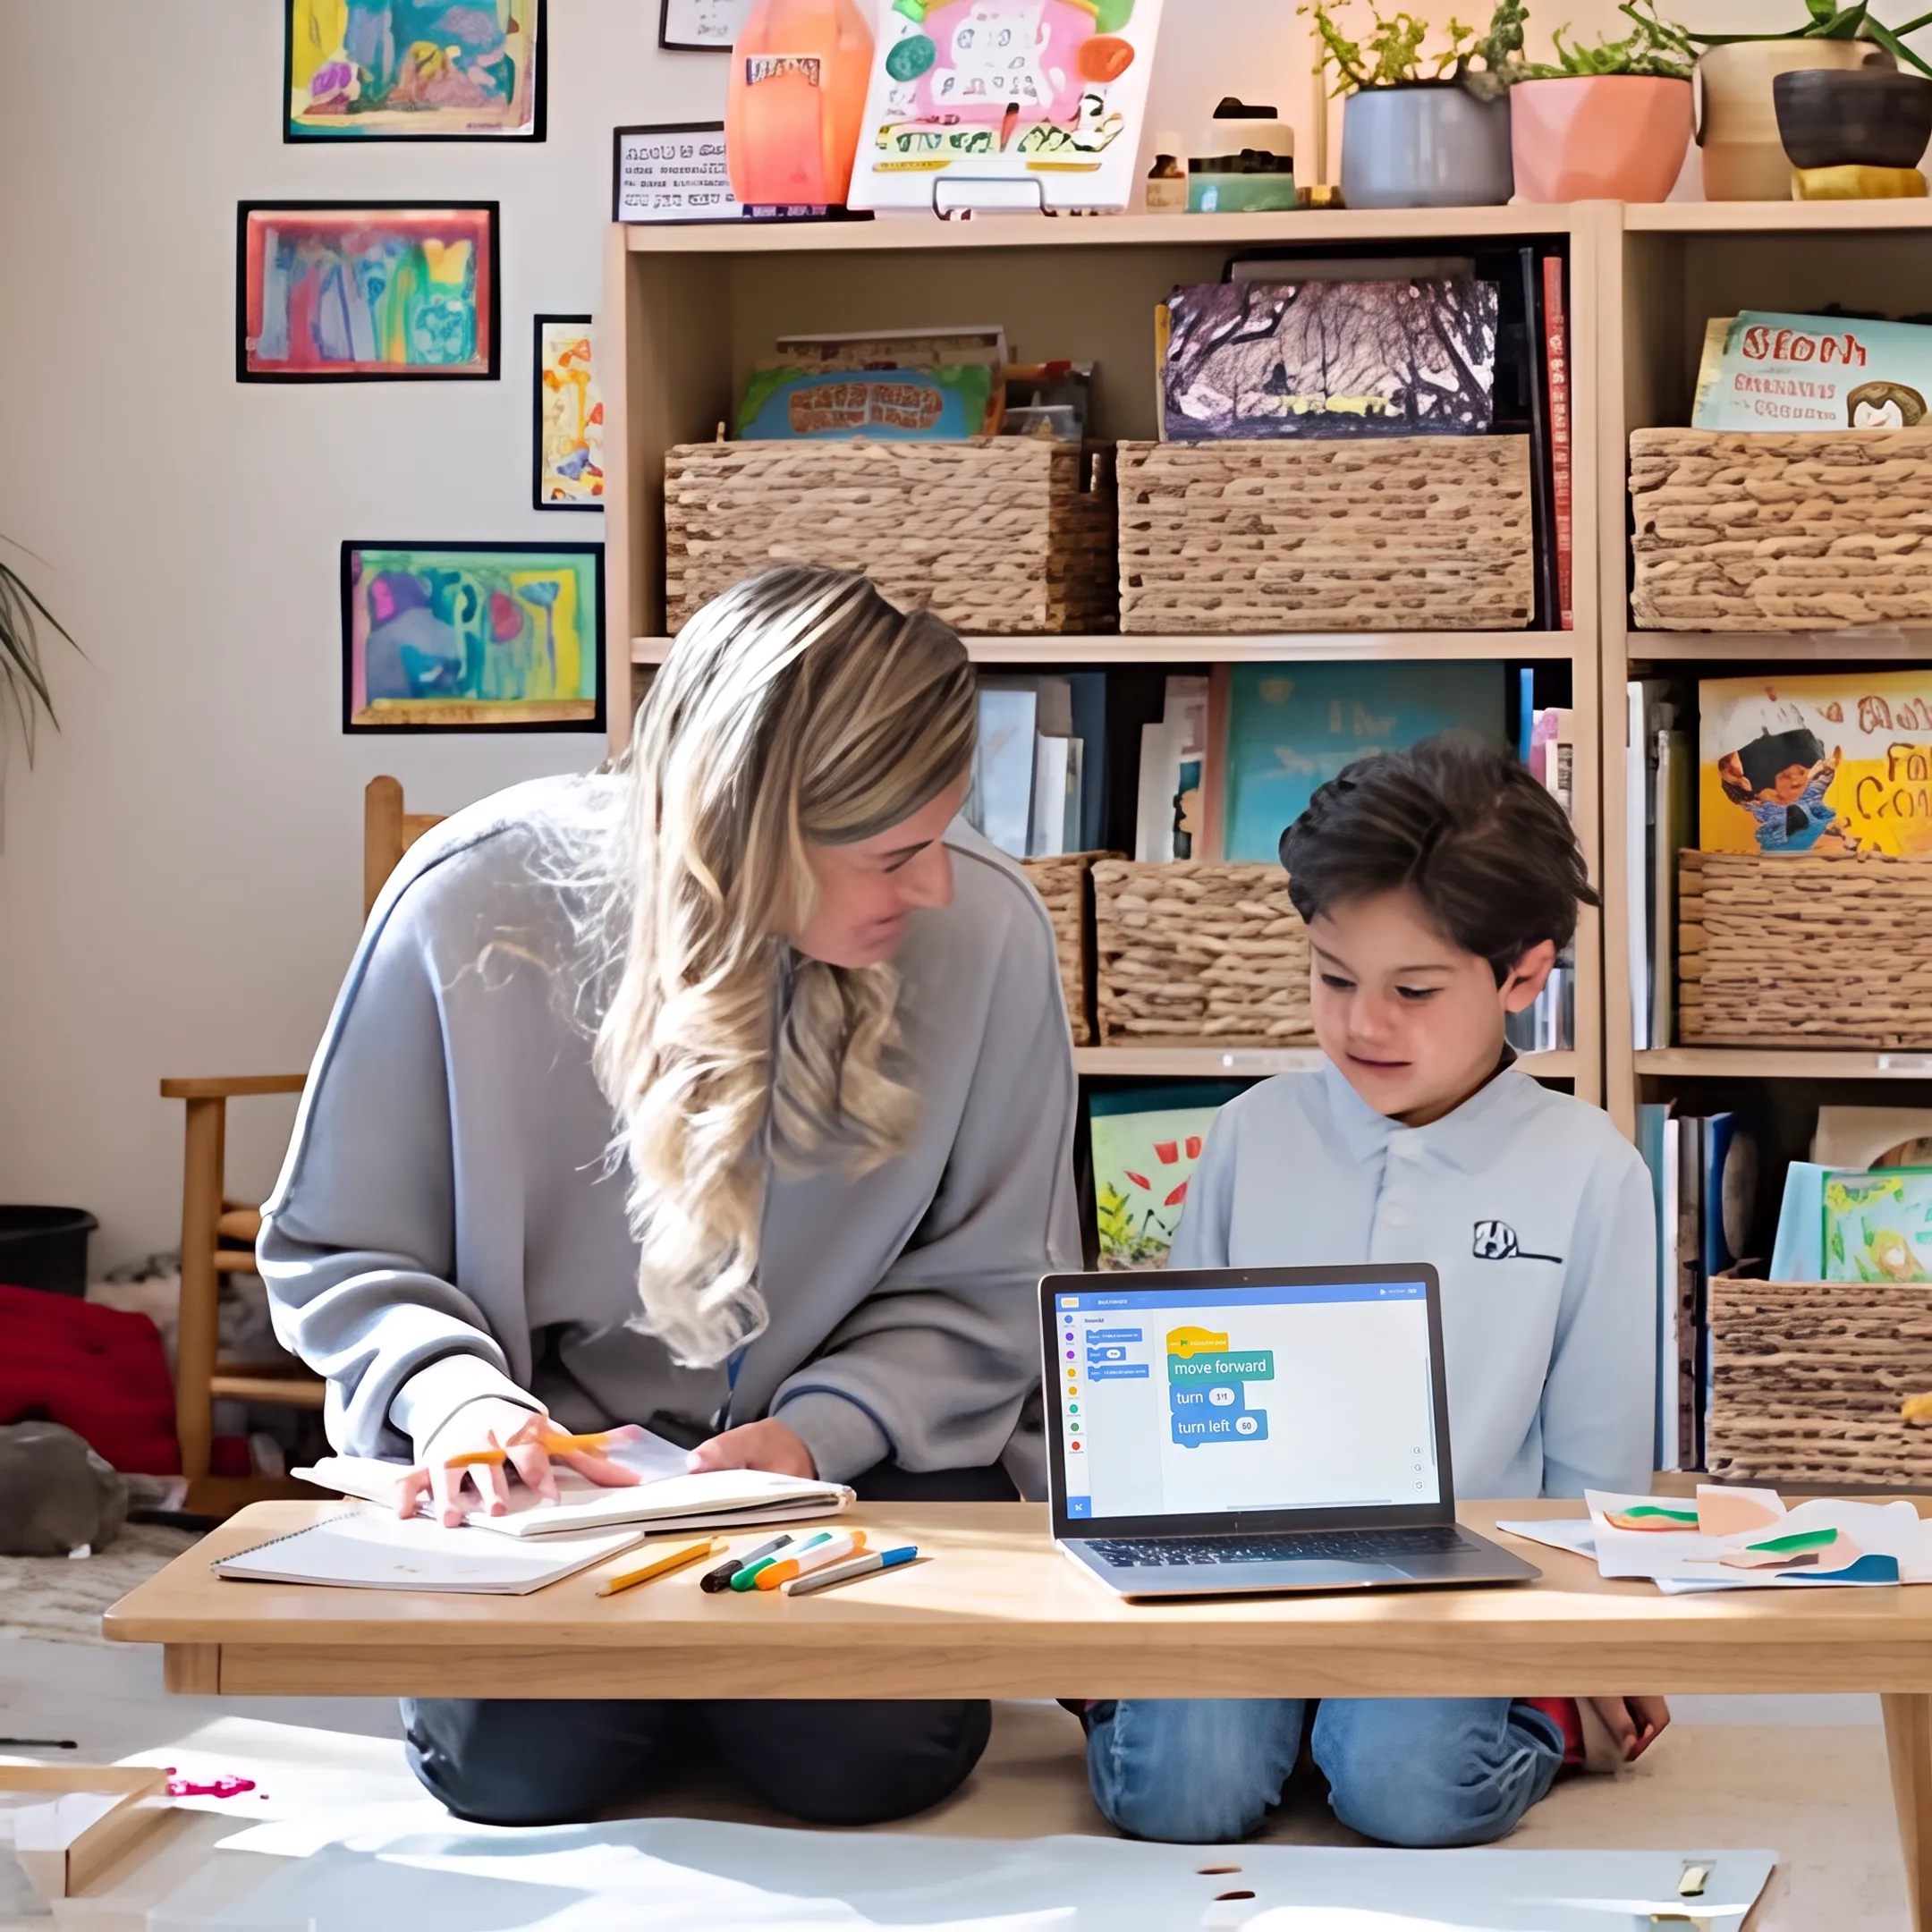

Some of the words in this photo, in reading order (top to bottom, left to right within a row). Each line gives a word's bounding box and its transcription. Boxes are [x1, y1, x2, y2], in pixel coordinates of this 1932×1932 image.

[1174, 1364, 1212, 1375] move
[1215, 1359, 1267, 1373] forward
[1176, 1393, 1204, 1404] turn
[1178, 1422, 1205, 1434] turn
[1208, 1419, 1231, 1433] left
